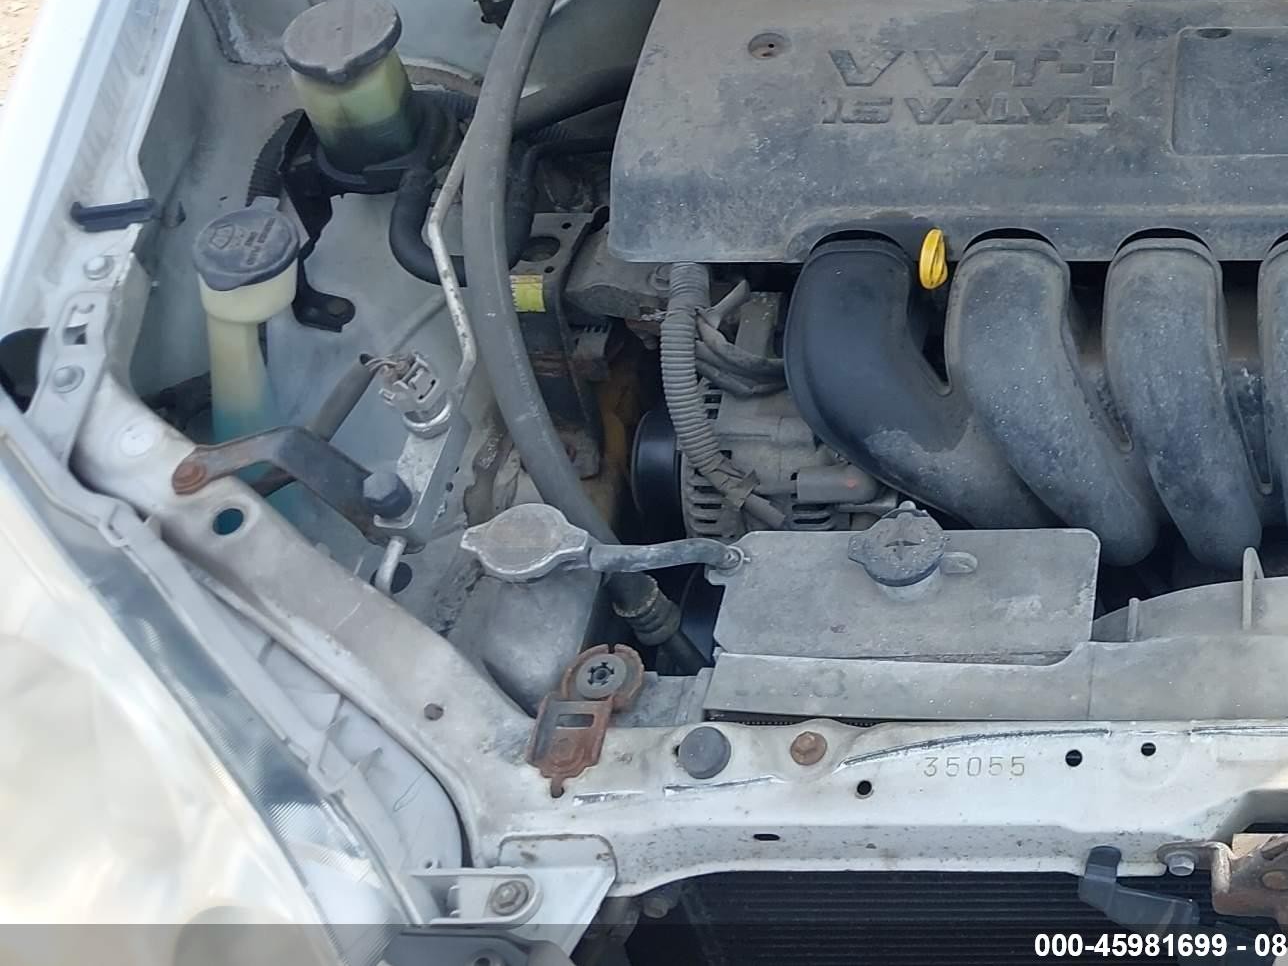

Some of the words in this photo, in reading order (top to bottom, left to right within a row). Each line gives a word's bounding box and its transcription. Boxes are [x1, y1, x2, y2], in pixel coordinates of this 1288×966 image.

[828, 49, 1117, 87] VVT-i
[903, 97, 1111, 125] VALVE
[923, 756, 1026, 777] 35055
